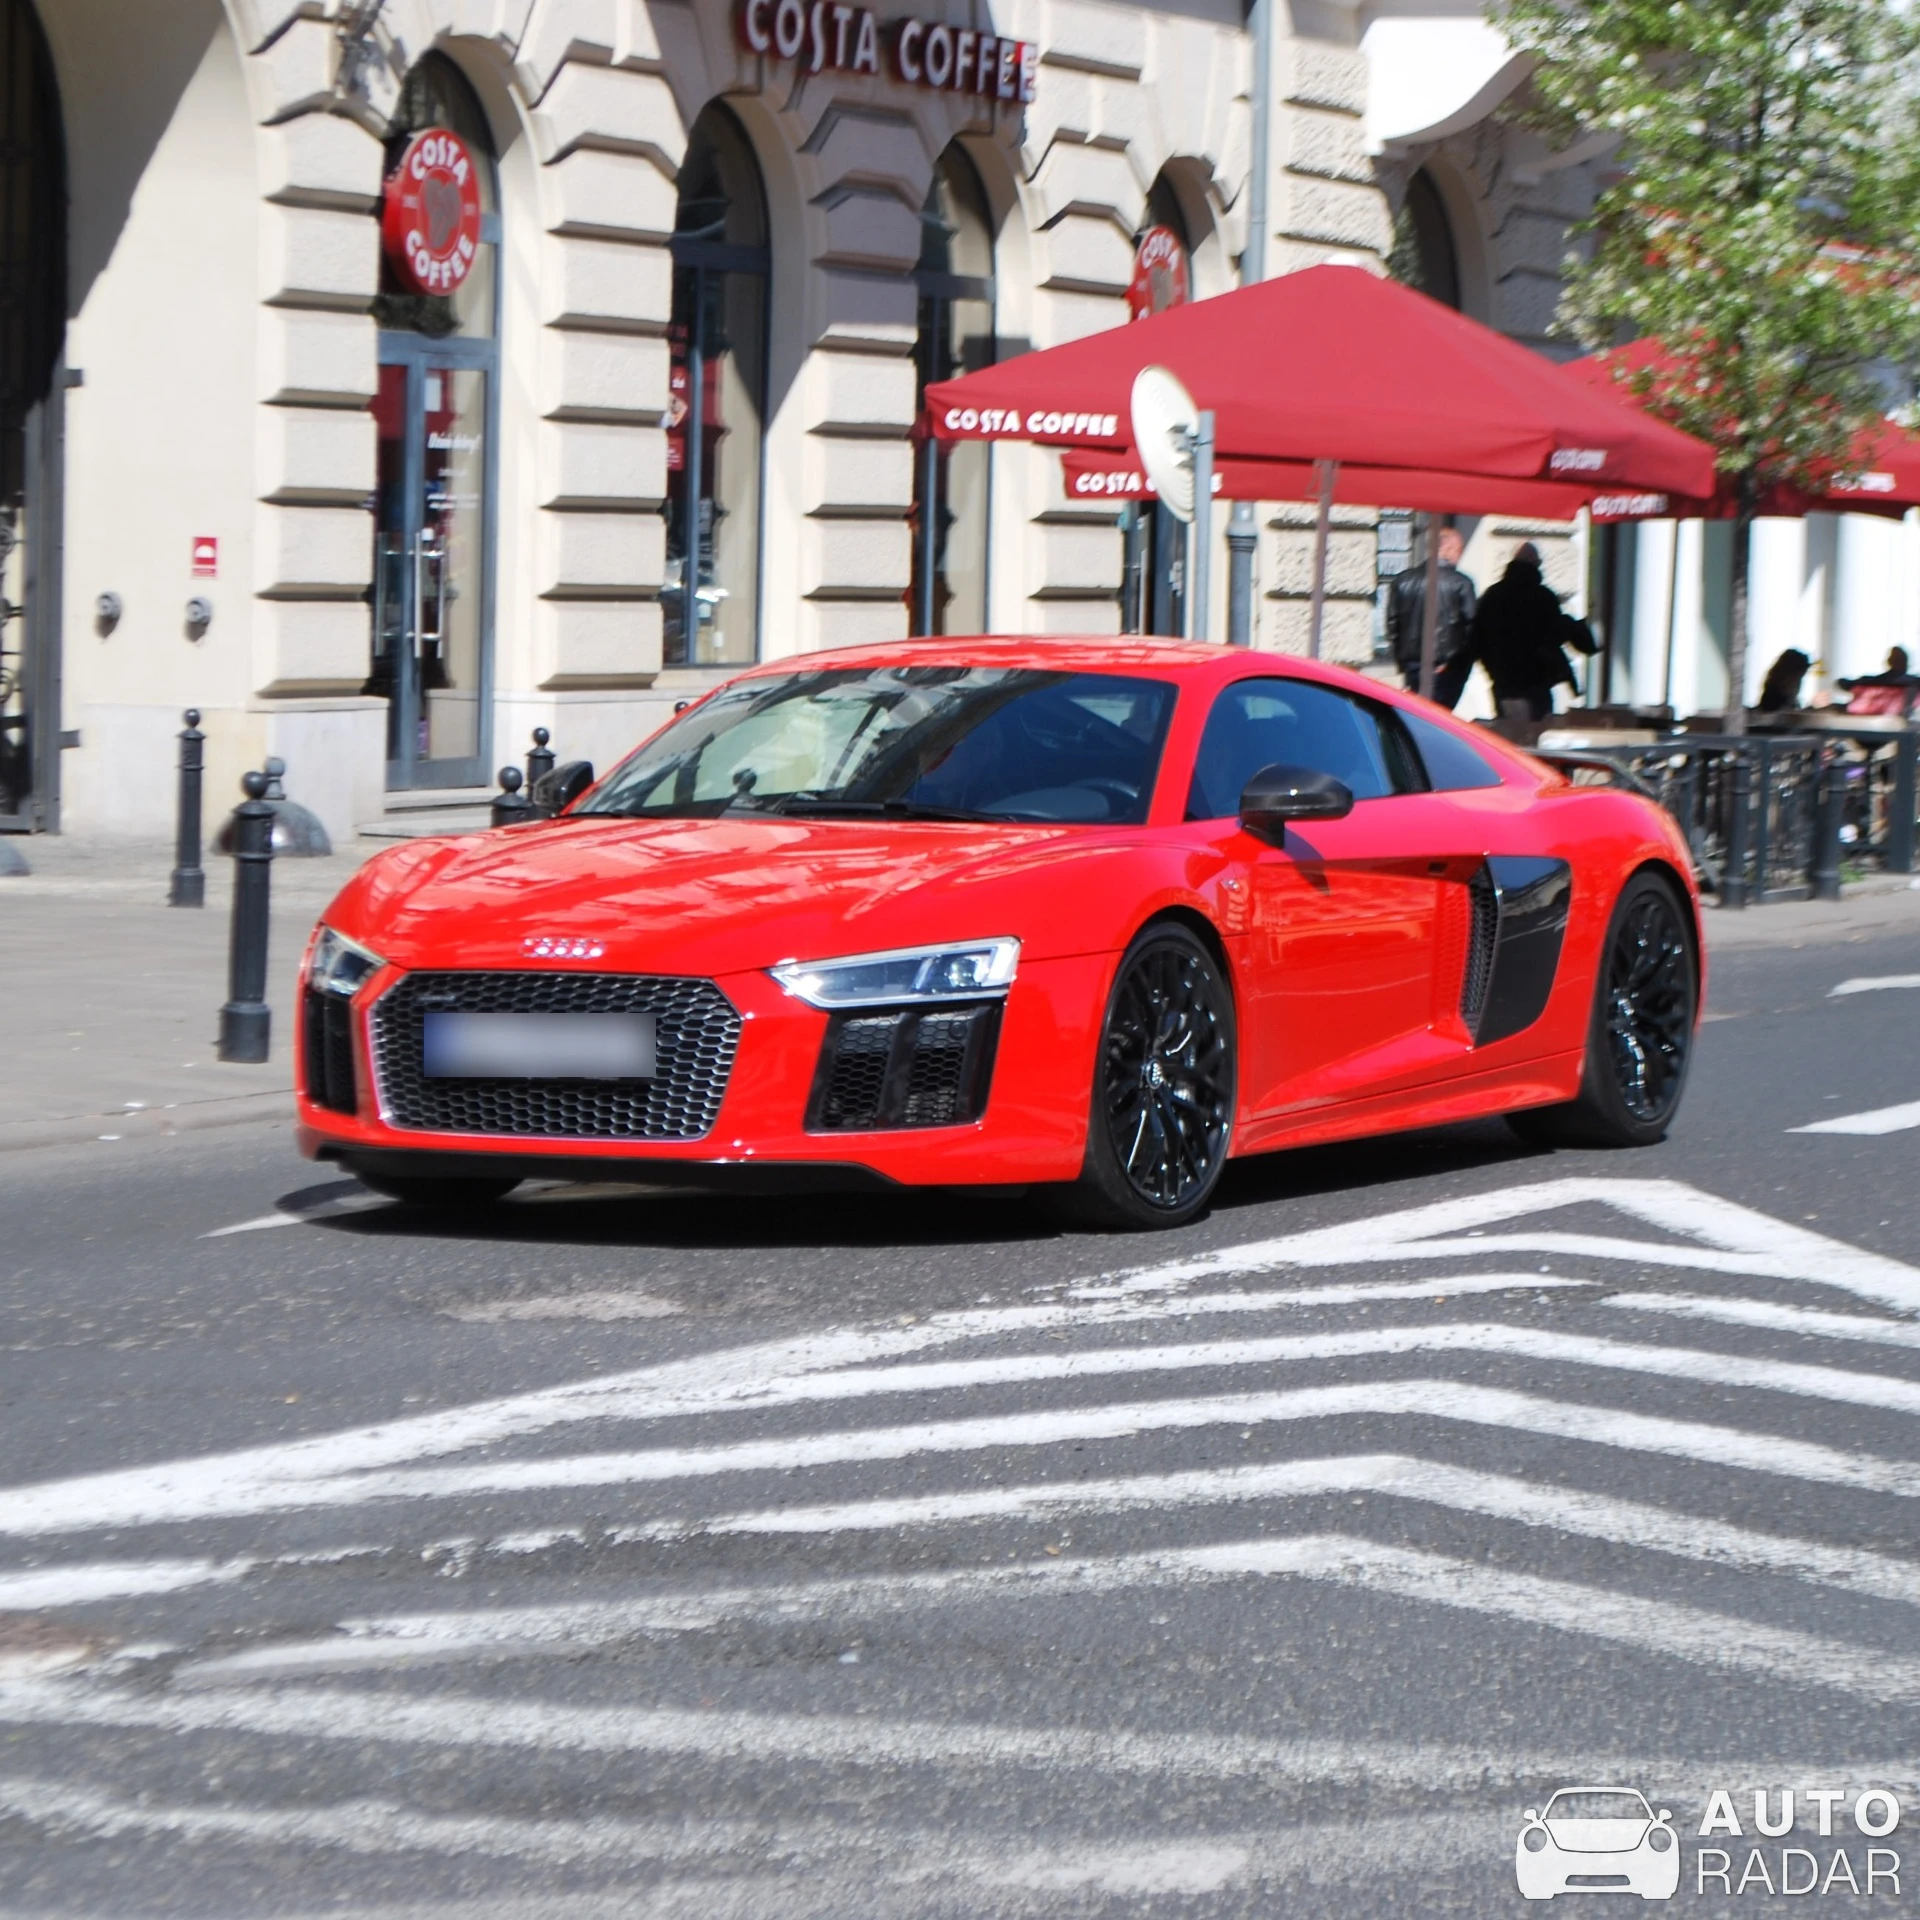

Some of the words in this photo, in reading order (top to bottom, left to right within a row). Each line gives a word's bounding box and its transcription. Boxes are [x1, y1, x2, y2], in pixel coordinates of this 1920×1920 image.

[746, 0, 879, 73] COSTA
[899, 19, 1038, 103] COFFEE
[411, 136, 468, 186] COSTA
[406, 230, 473, 288] COFFEE
[944, 407, 1021, 434] COSTA
[1026, 411, 1118, 436] COFFEE
[1075, 471, 1142, 494] COSTA
